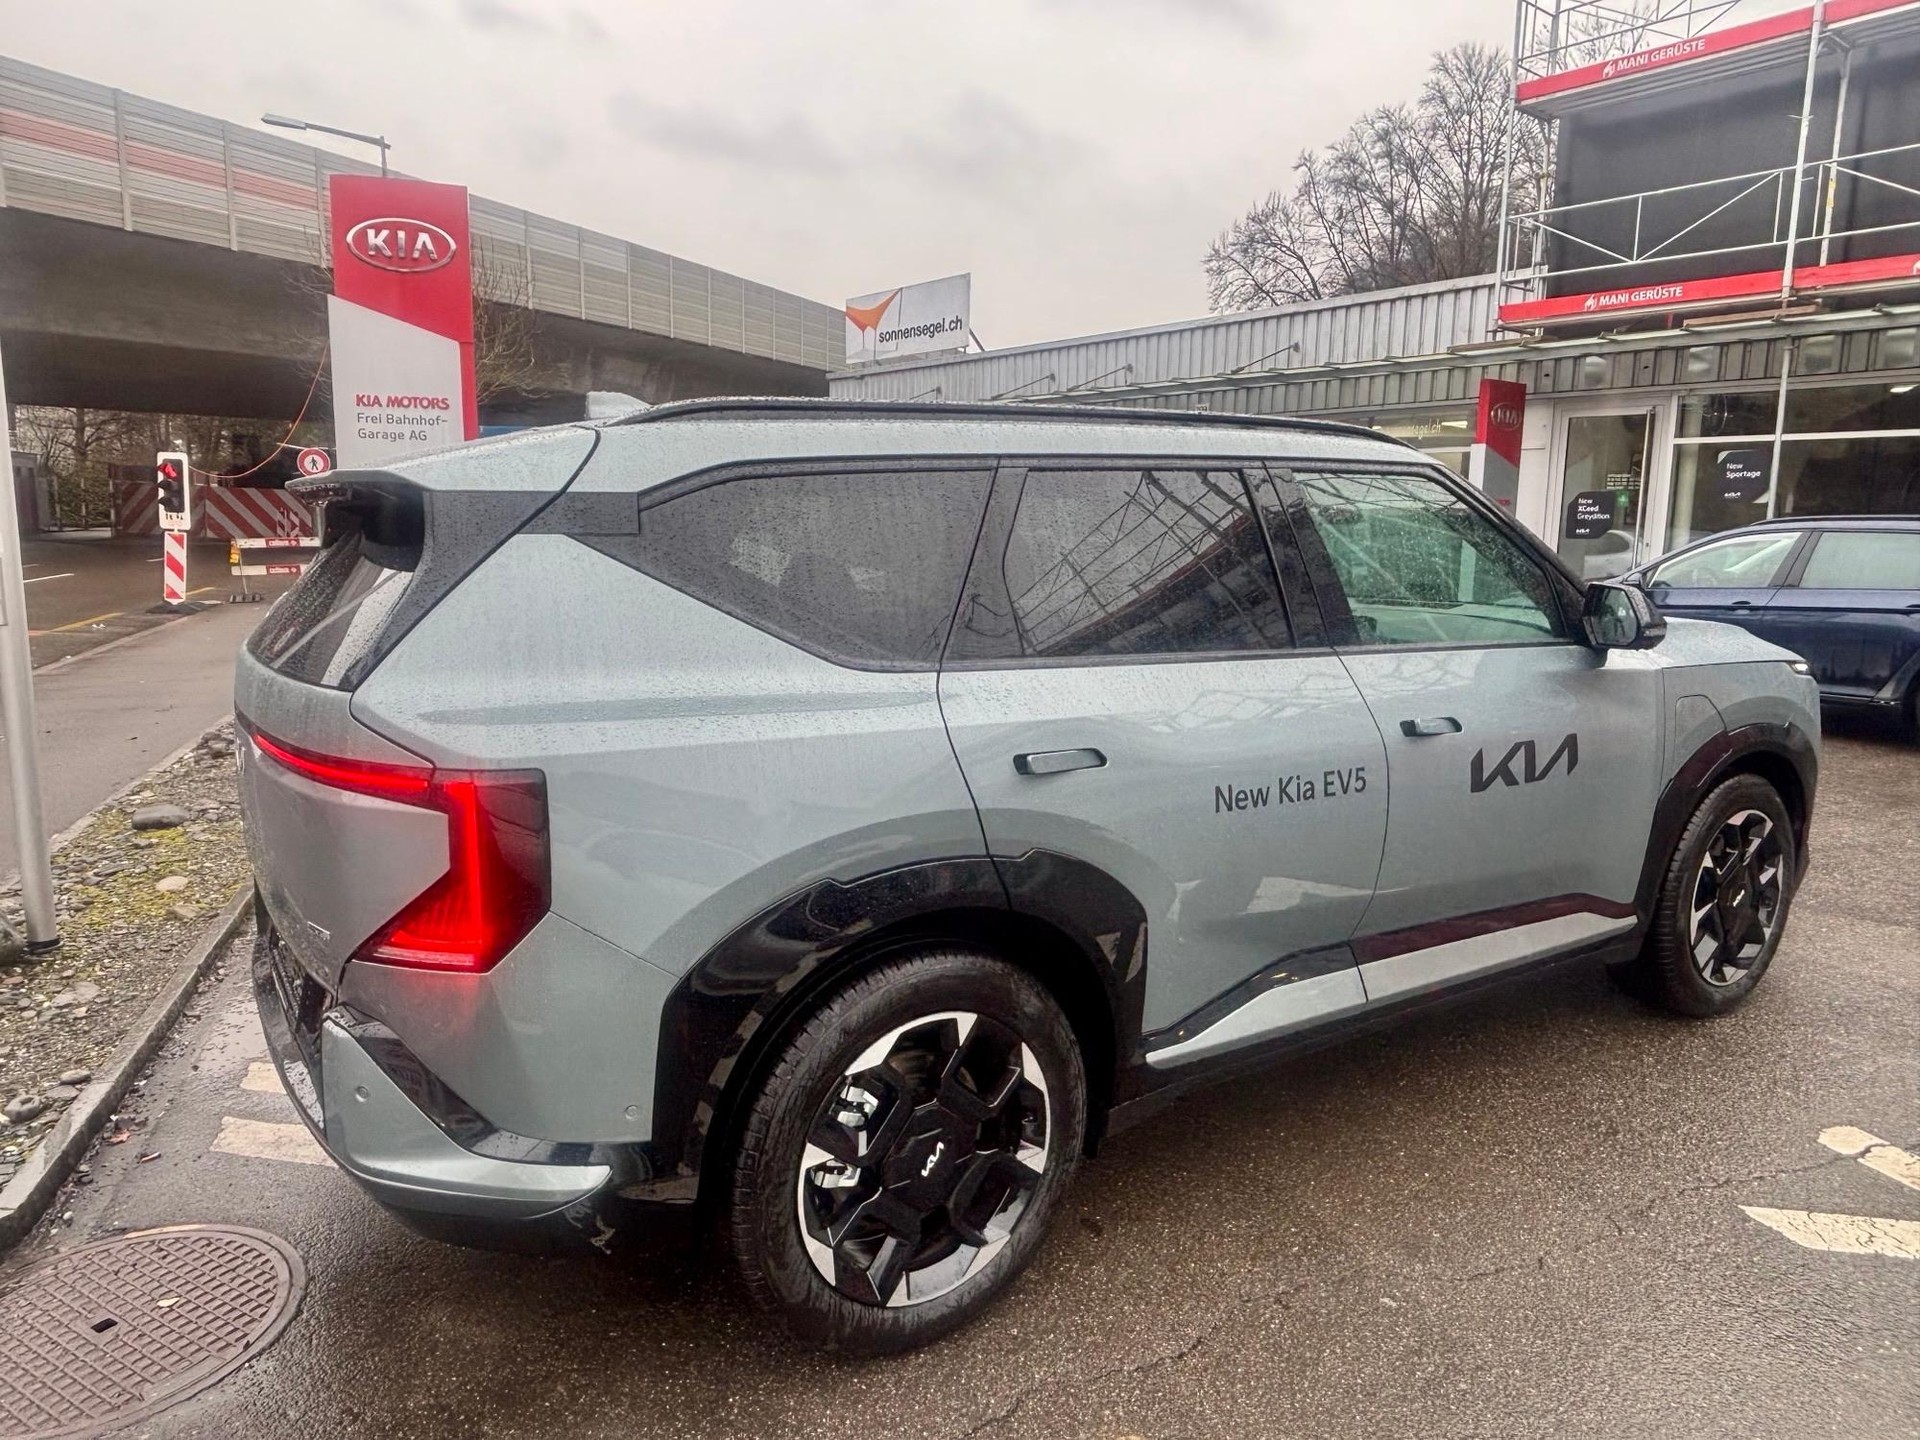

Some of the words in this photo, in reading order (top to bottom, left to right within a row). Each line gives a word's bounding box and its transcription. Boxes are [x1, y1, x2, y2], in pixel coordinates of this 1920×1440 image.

[1616, 53, 1649, 71] MANI
[1650, 39, 1706, 62] GERÜSTE
[366, 228, 438, 260] KIA
[1598, 293, 1629, 306] MANI
[1630, 286, 1683, 301] GERÜSTE
[878, 315, 963, 343] sonnensegel.ch
[355, 394, 383, 408] KIA
[386, 395, 450, 410] MOTORS
[357, 412, 382, 423] Frei
[386, 413, 448, 426] Bahnhof-
[357, 428, 405, 442] Garage
[408, 430, 428, 441] AG
[1725, 470, 1761, 479] Sportage
[1470, 732, 1579, 793] KIA
[1214, 783, 1271, 814] New
[1278, 774, 1315, 805] Kia
[1323, 766, 1367, 798] EV5
